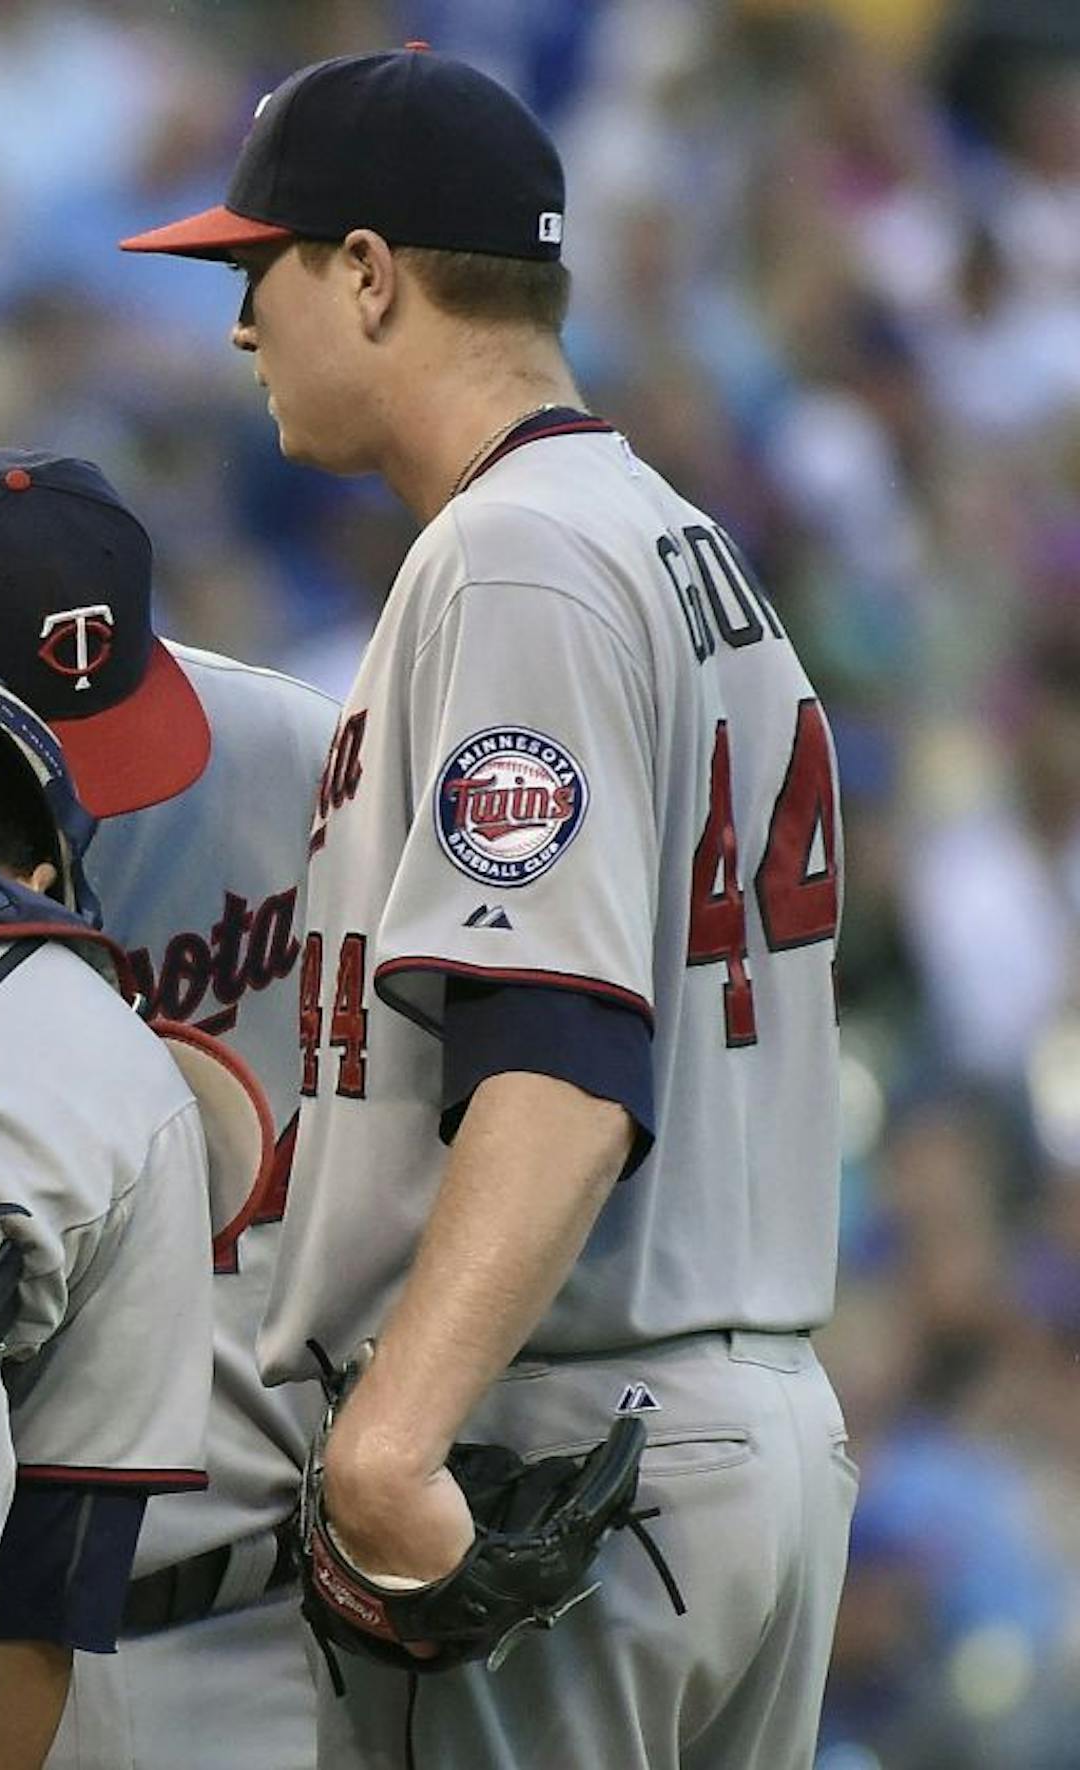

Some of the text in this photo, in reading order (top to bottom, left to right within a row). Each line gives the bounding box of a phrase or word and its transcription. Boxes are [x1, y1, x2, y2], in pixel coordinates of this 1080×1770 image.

[457, 735, 576, 787] MINNESOTA
[444, 775, 575, 832] Twins
[448, 831, 560, 878] BASEBALL CLUB
[687, 698, 838, 1048] 44
[299, 931, 369, 1099] 44
